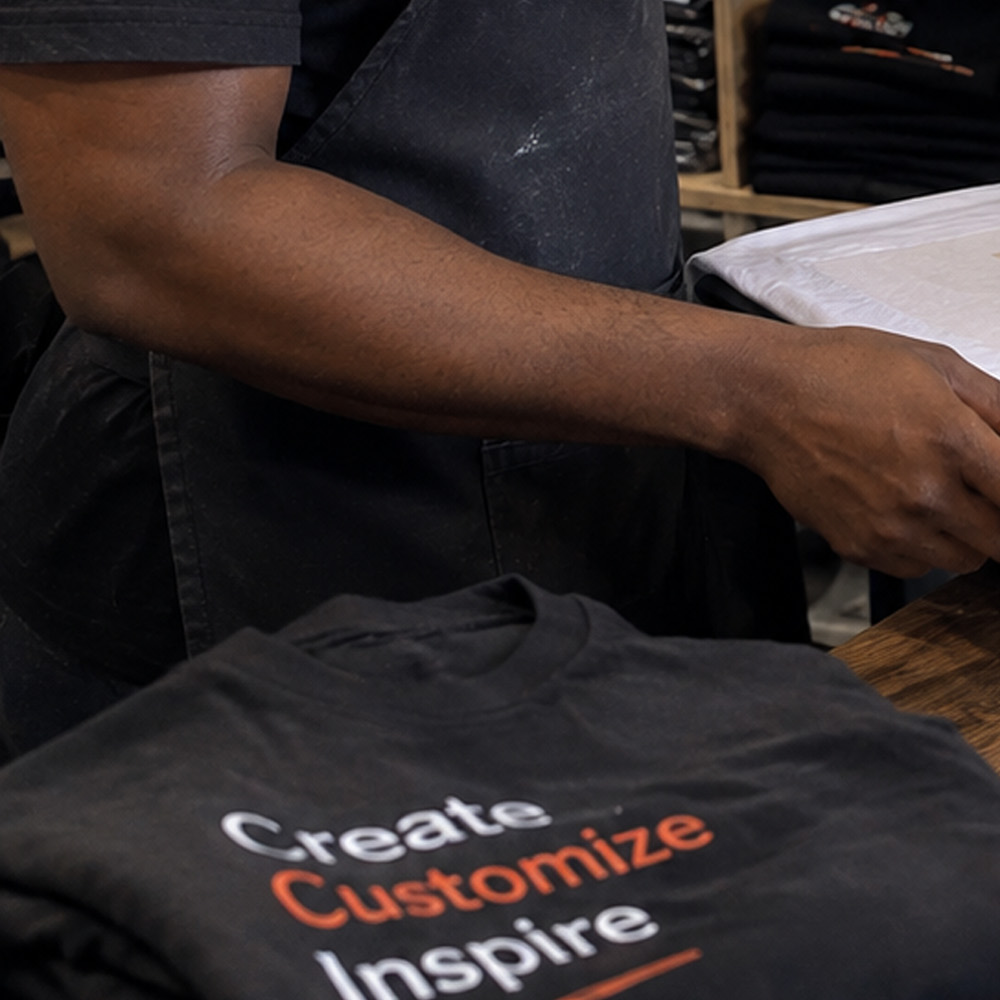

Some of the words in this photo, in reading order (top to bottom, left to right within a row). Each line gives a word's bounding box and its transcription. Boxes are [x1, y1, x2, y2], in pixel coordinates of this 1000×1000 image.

[220, 796, 553, 865] Create
[271, 815, 713, 929] Customize
[314, 905, 659, 1000] Inspire
